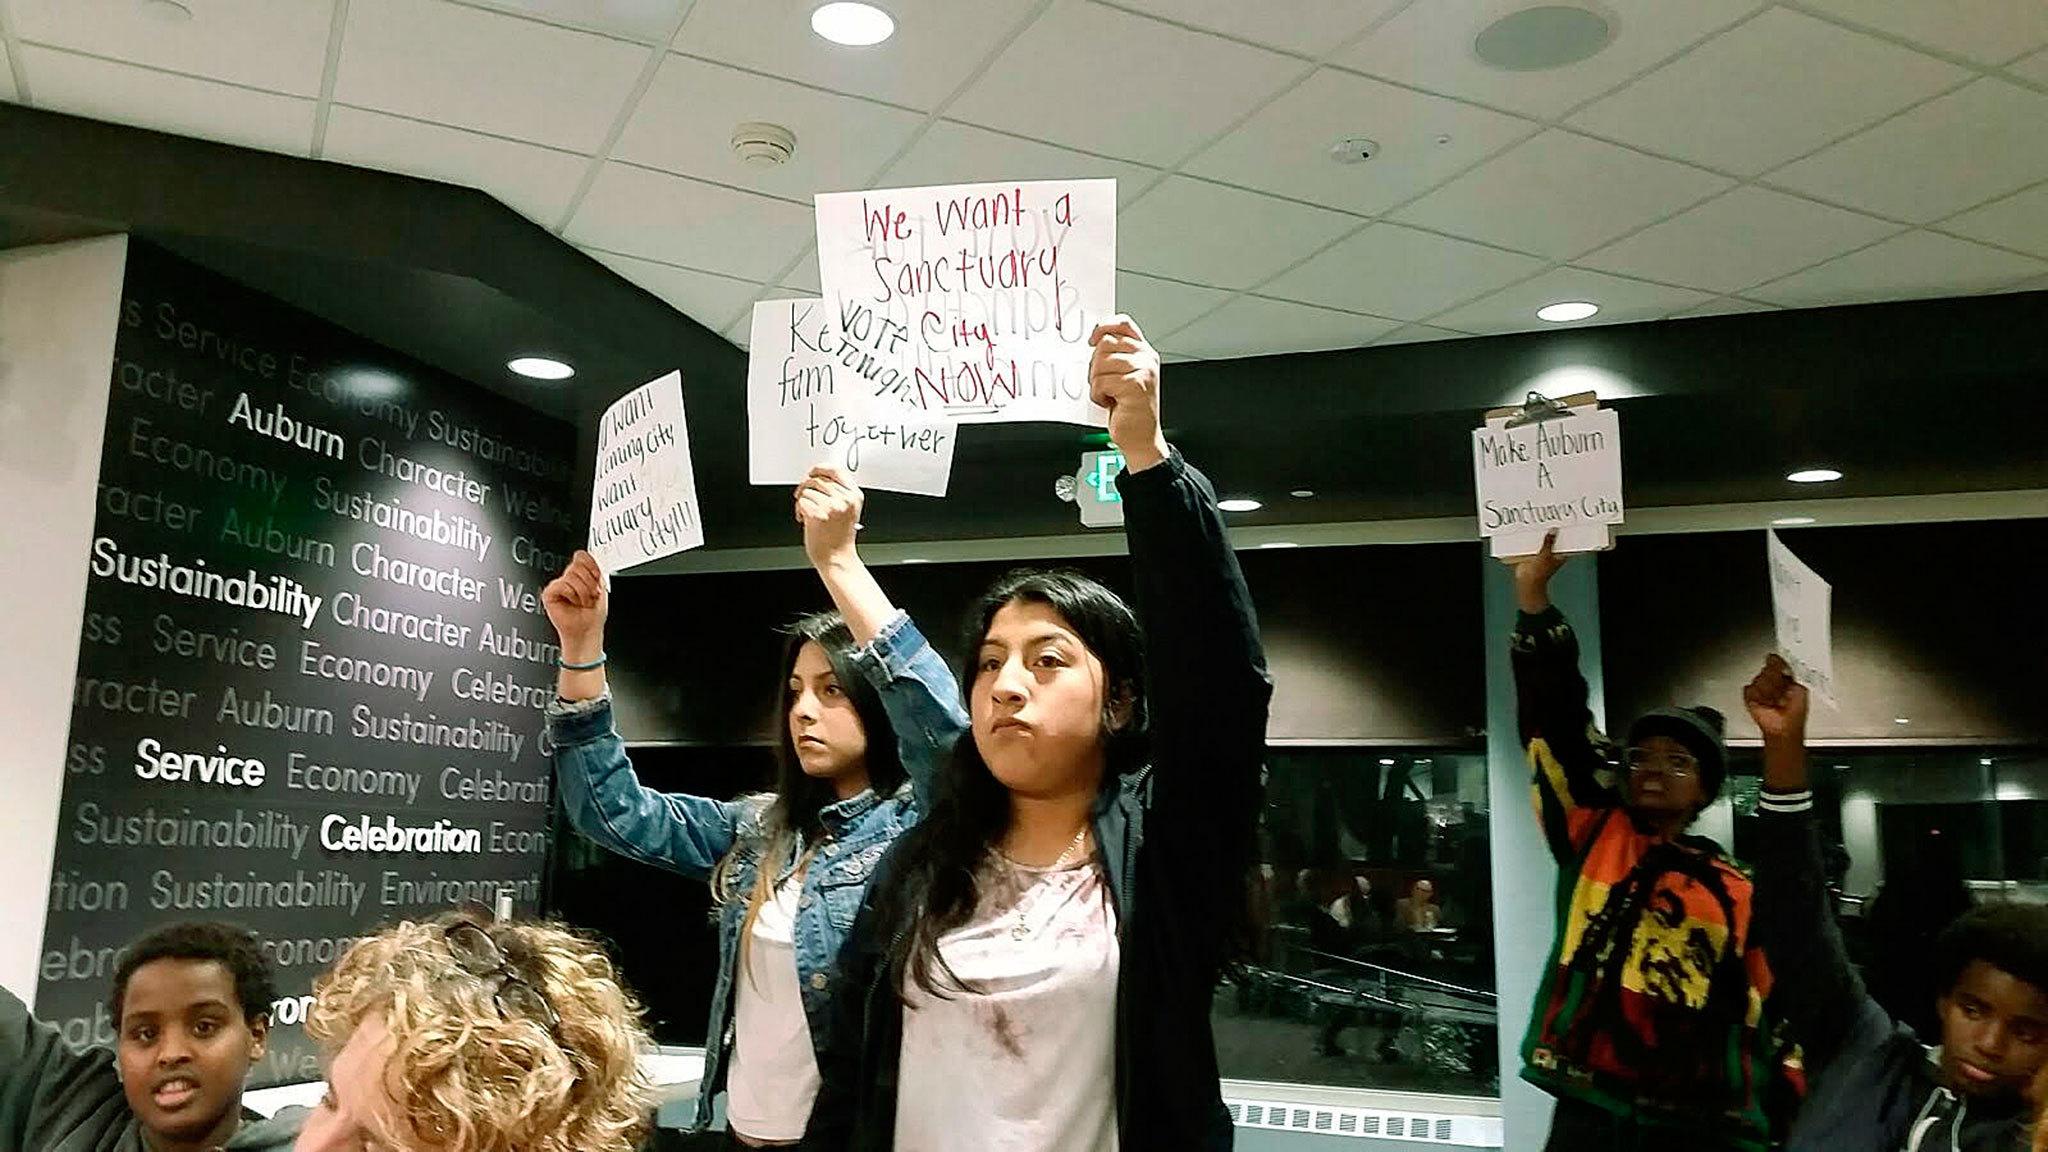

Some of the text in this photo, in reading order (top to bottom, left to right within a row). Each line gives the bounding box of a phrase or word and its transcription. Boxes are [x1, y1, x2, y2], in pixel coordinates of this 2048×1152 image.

[863, 187, 1072, 242] We want a
[874, 245, 1063, 331] Sanctuary
[155, 302, 277, 378] Service
[288, 354, 420, 440] Ecoomy
[920, 310, 997, 370] City
[914, 359, 1016, 410] NOW
[227, 391, 344, 461] Auburn
[358, 436, 492, 506] Character
[1480, 421, 1605, 469] Make Auburn
[1538, 462, 1554, 489] A
[130, 416, 288, 503] Economy
[314, 476, 493, 563] Sustainability
[1098, 454, 1126, 502] E
[100, 483, 204, 534] acter
[221, 506, 335, 568] Auburn
[351, 542, 487, 603] Character
[1485, 500, 1577, 529] Sanctuary
[91, 537, 322, 630] Sustainability
[331, 591, 472, 649] Character
[152, 613, 277, 670] Service
[300, 639, 434, 701] Economy
[216, 685, 334, 736] Auburn
[350, 703, 525, 763] Sustainability
[134, 737, 266, 787] Service
[287, 752, 423, 805] Economy
[74, 802, 311, 860] Sustainability
[320, 813, 481, 854] Celebration
[149, 869, 367, 916] Sustainability
[379, 870, 541, 906] Environment
